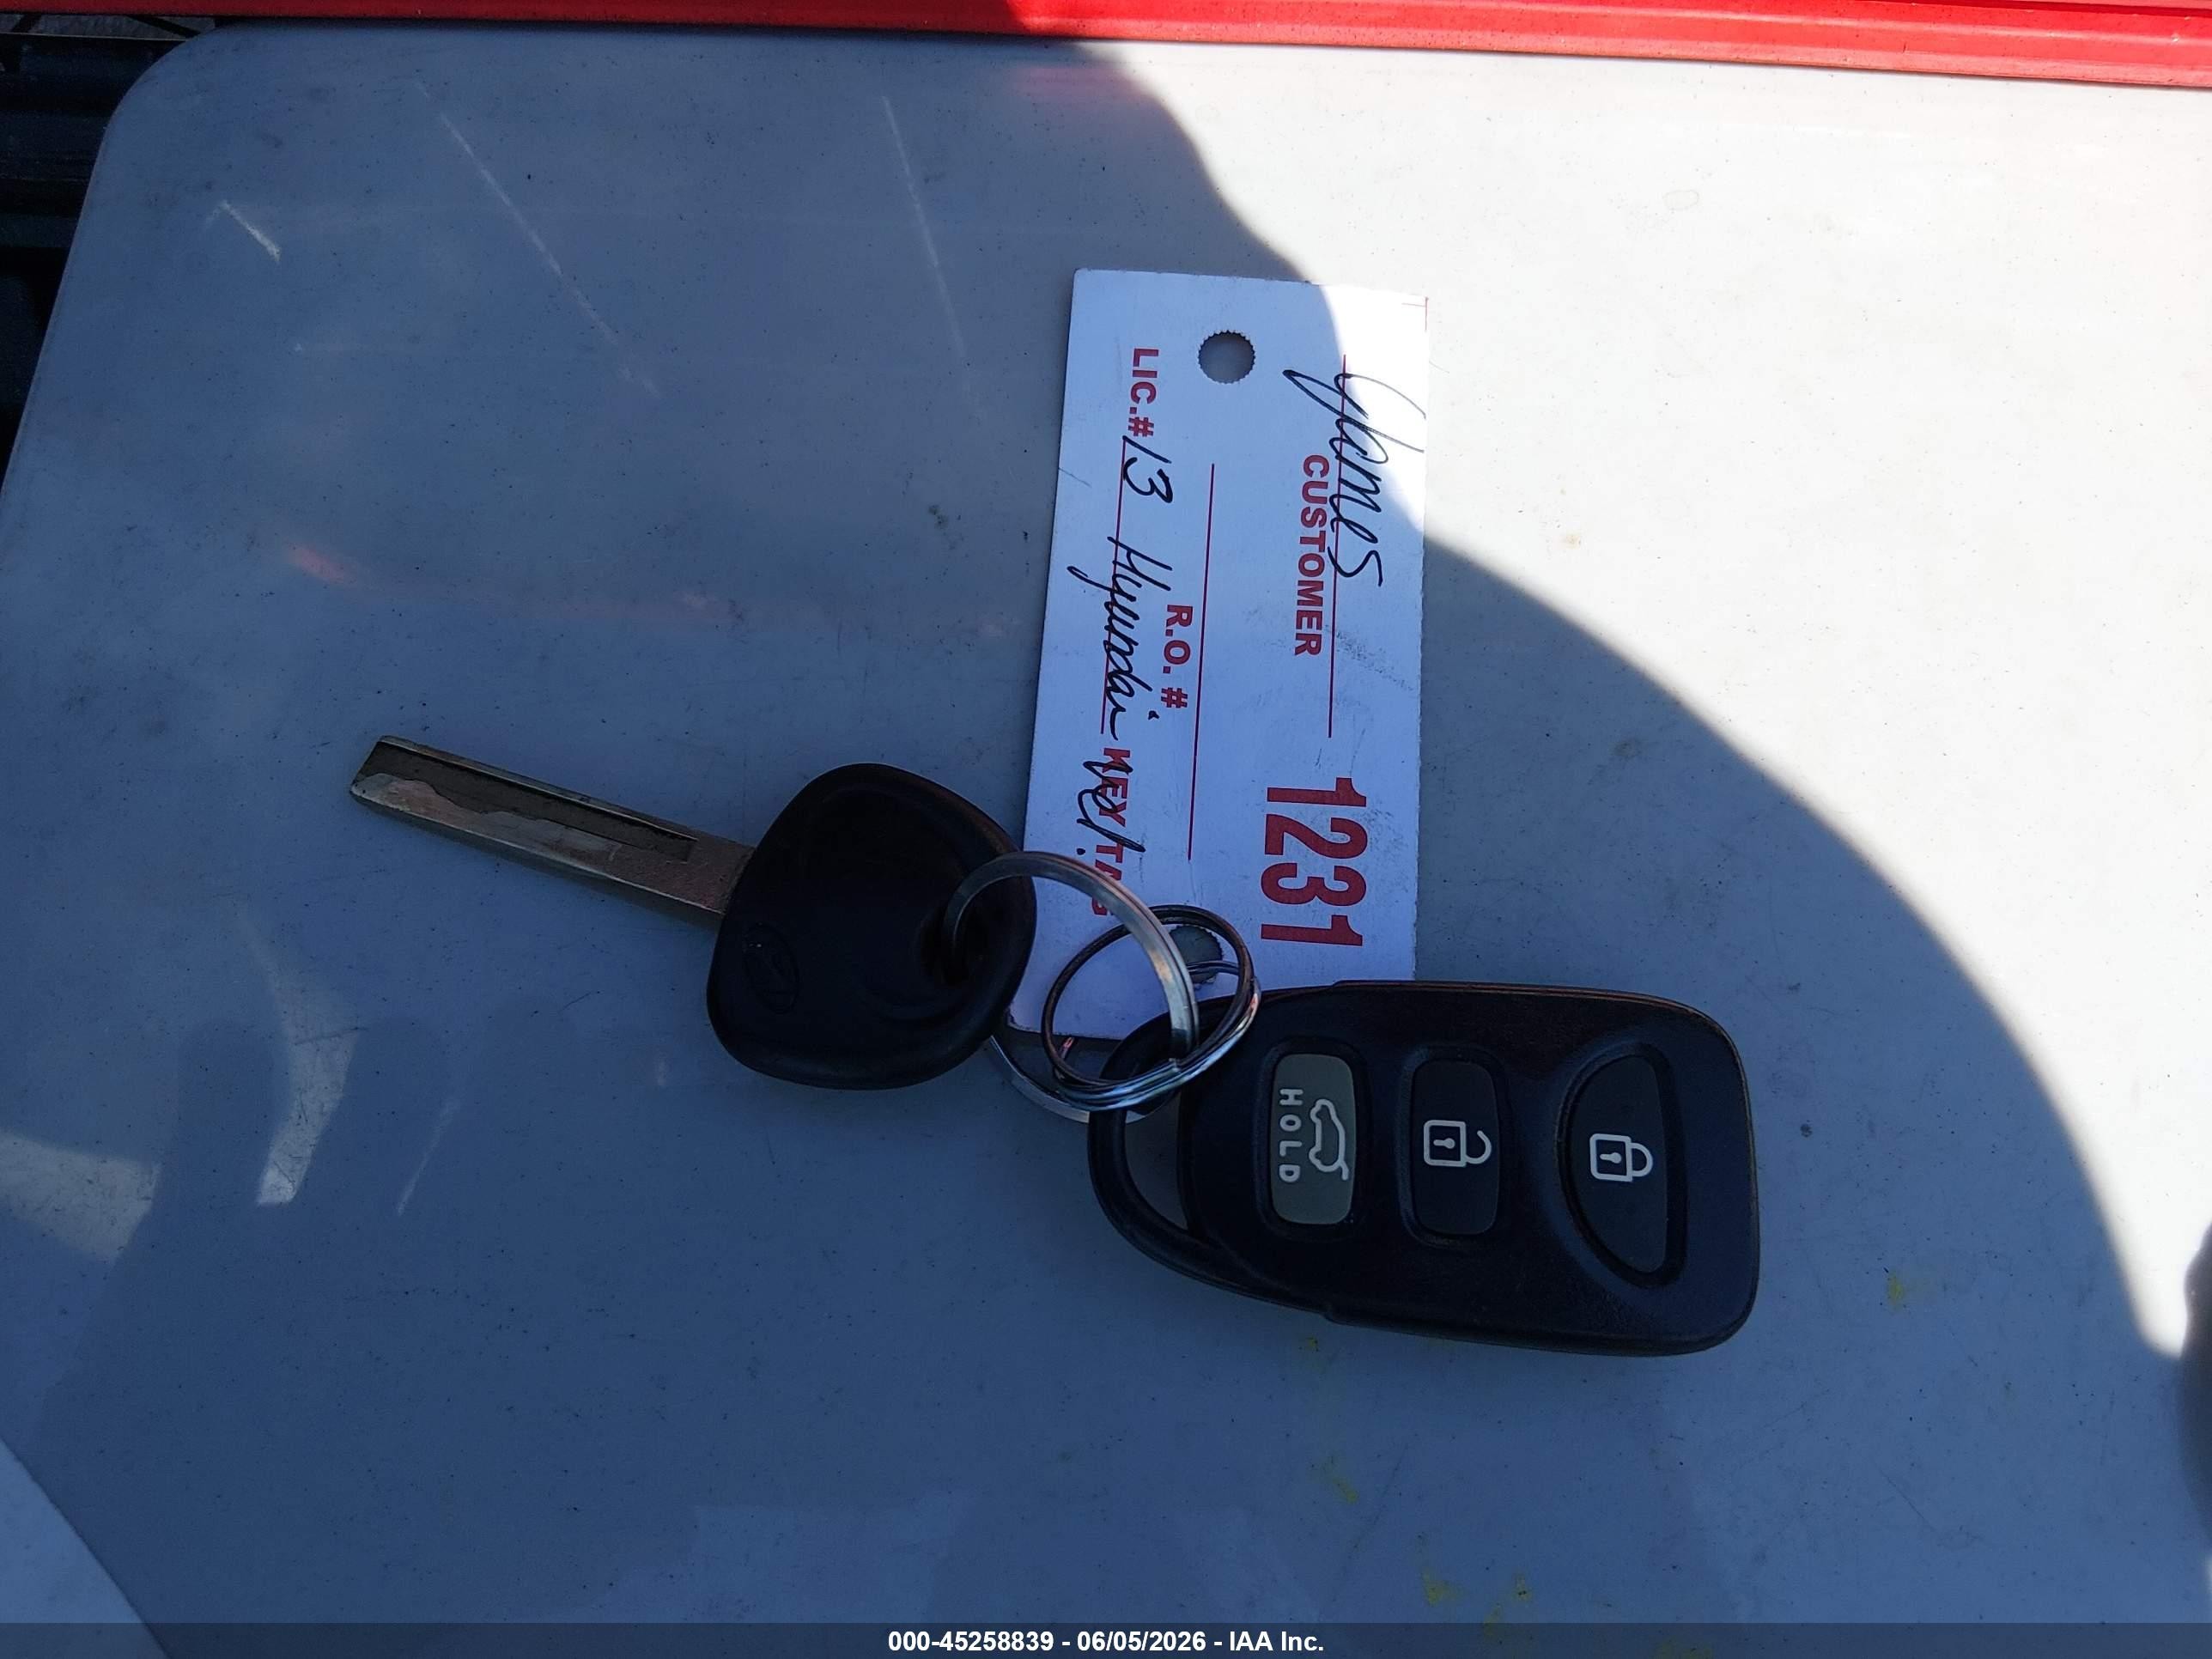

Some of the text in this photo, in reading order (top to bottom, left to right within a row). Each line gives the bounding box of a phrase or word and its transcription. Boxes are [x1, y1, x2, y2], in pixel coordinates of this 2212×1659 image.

[1127, 348, 1159, 437] LIC.#
[1121, 434, 1174, 503] 13
[1282, 368, 1426, 587] James
[1294, 454, 1330, 656] CUSTOMER
[1066, 536, 1173, 741] Hyundai
[1160, 604, 1194, 708] R.O. #
[1098, 747, 1131, 828] KEY
[1261, 776, 1368, 946] 1231
[1279, 1088, 1304, 1182] HOLD
